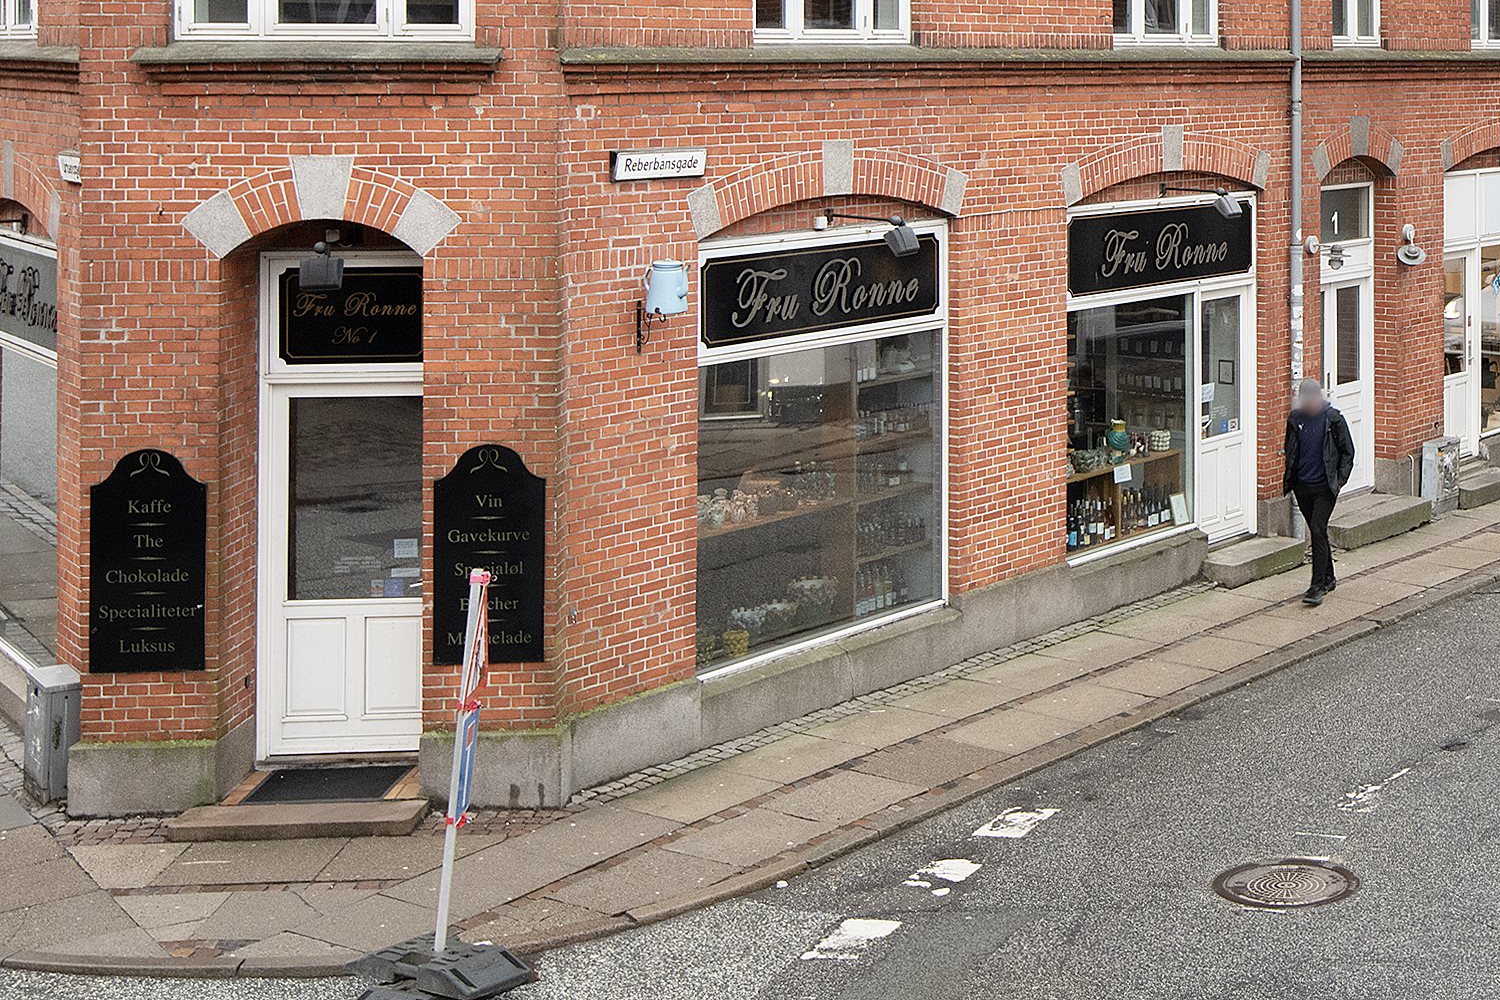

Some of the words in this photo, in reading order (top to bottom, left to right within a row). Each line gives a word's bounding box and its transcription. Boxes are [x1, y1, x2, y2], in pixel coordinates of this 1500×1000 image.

[624, 156, 699, 173] Reberbansgade
[1331, 210, 1338, 235] 1
[1101, 229, 1148, 278] Fru
[1155, 222, 1228, 271] Ronne
[731, 267, 800, 328] Fru
[812, 257, 920, 316] Ronne
[293, 291, 336, 317] Fru
[343, 291, 417, 317] Ronne
[128, 499, 172, 514] Kaffe
[475, 494, 503, 508] Vin
[133, 534, 164, 548] The
[447, 528, 530, 543] Gavekurve
[105, 568, 190, 584] Chokolade
[99, 604, 197, 622] Specialiteter
[119, 639, 176, 654] Luksus
